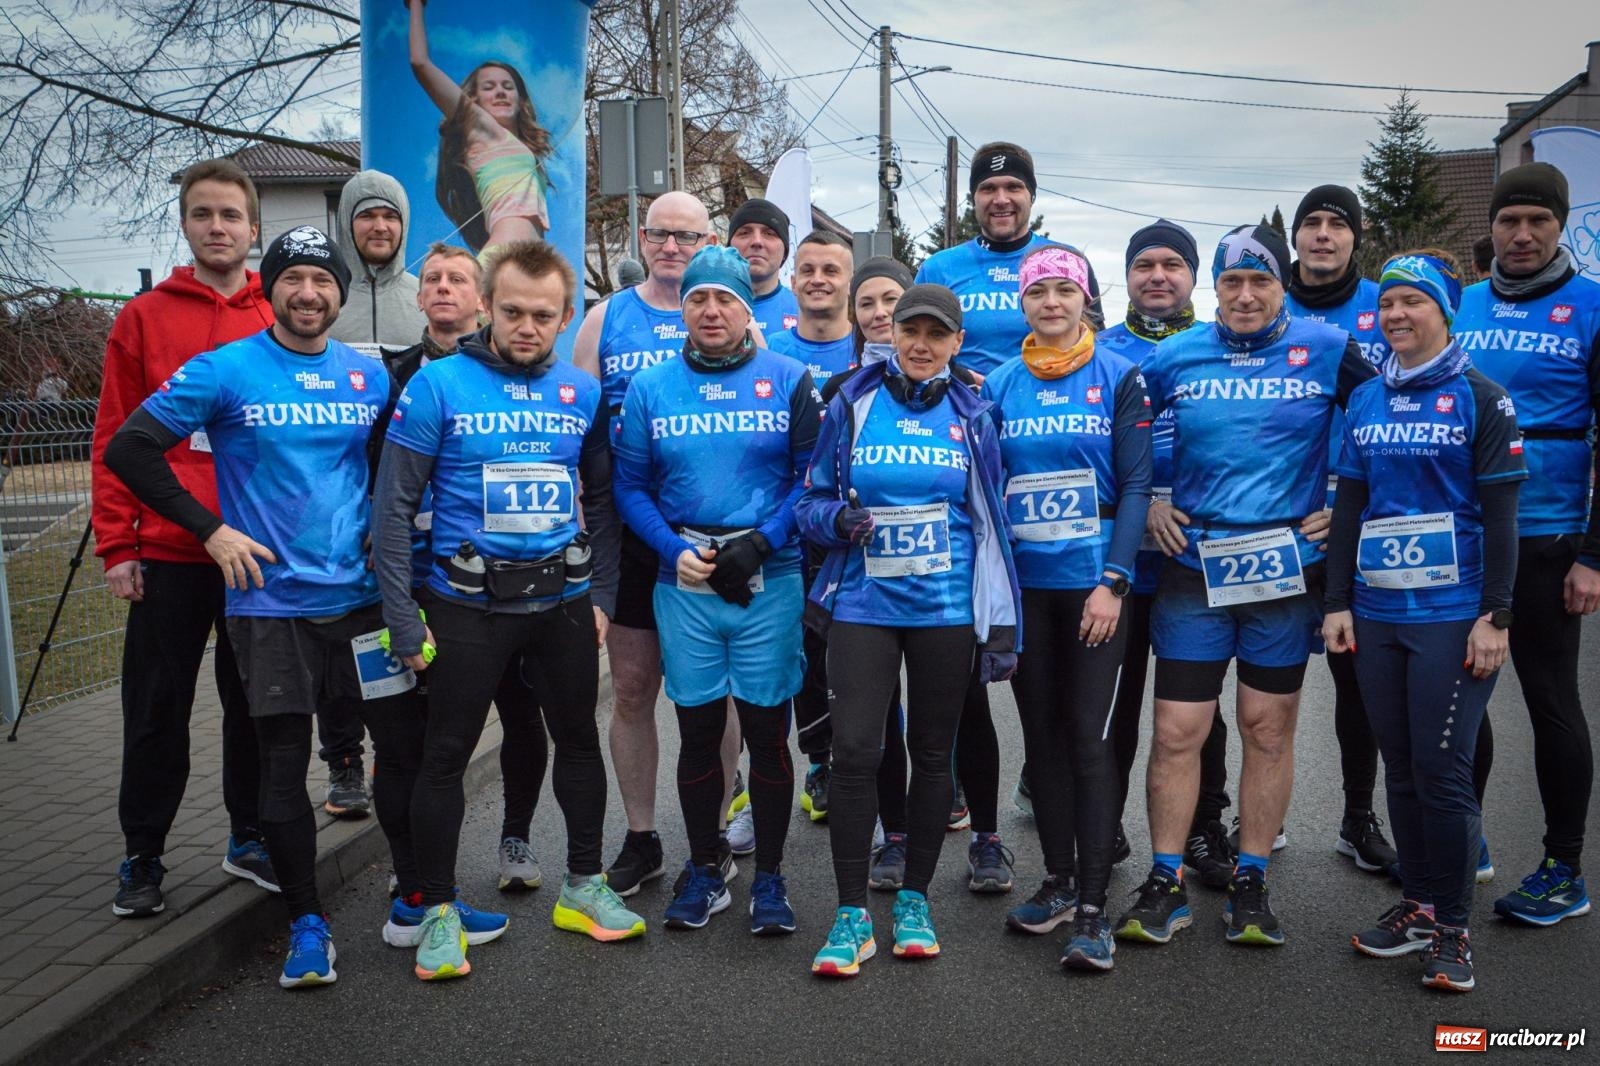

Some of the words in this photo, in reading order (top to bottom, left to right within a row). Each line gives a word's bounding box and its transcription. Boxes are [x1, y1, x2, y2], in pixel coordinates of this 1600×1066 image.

[1455, 329, 1580, 360] UNNERS
[1174, 378, 1322, 400] RUNNERS
[243, 403, 379, 427] RUNNERS
[453, 411, 589, 436] RUNNERS
[652, 411, 790, 440] RUNNERS
[502, 442, 550, 455] JACEK
[1410, 448, 1439, 457] TEAM
[503, 483, 560, 511] 112
[1020, 489, 1081, 522] 162
[878, 524, 936, 555] 154
[1382, 536, 1425, 567] 36
[1220, 550, 1284, 584] 223
